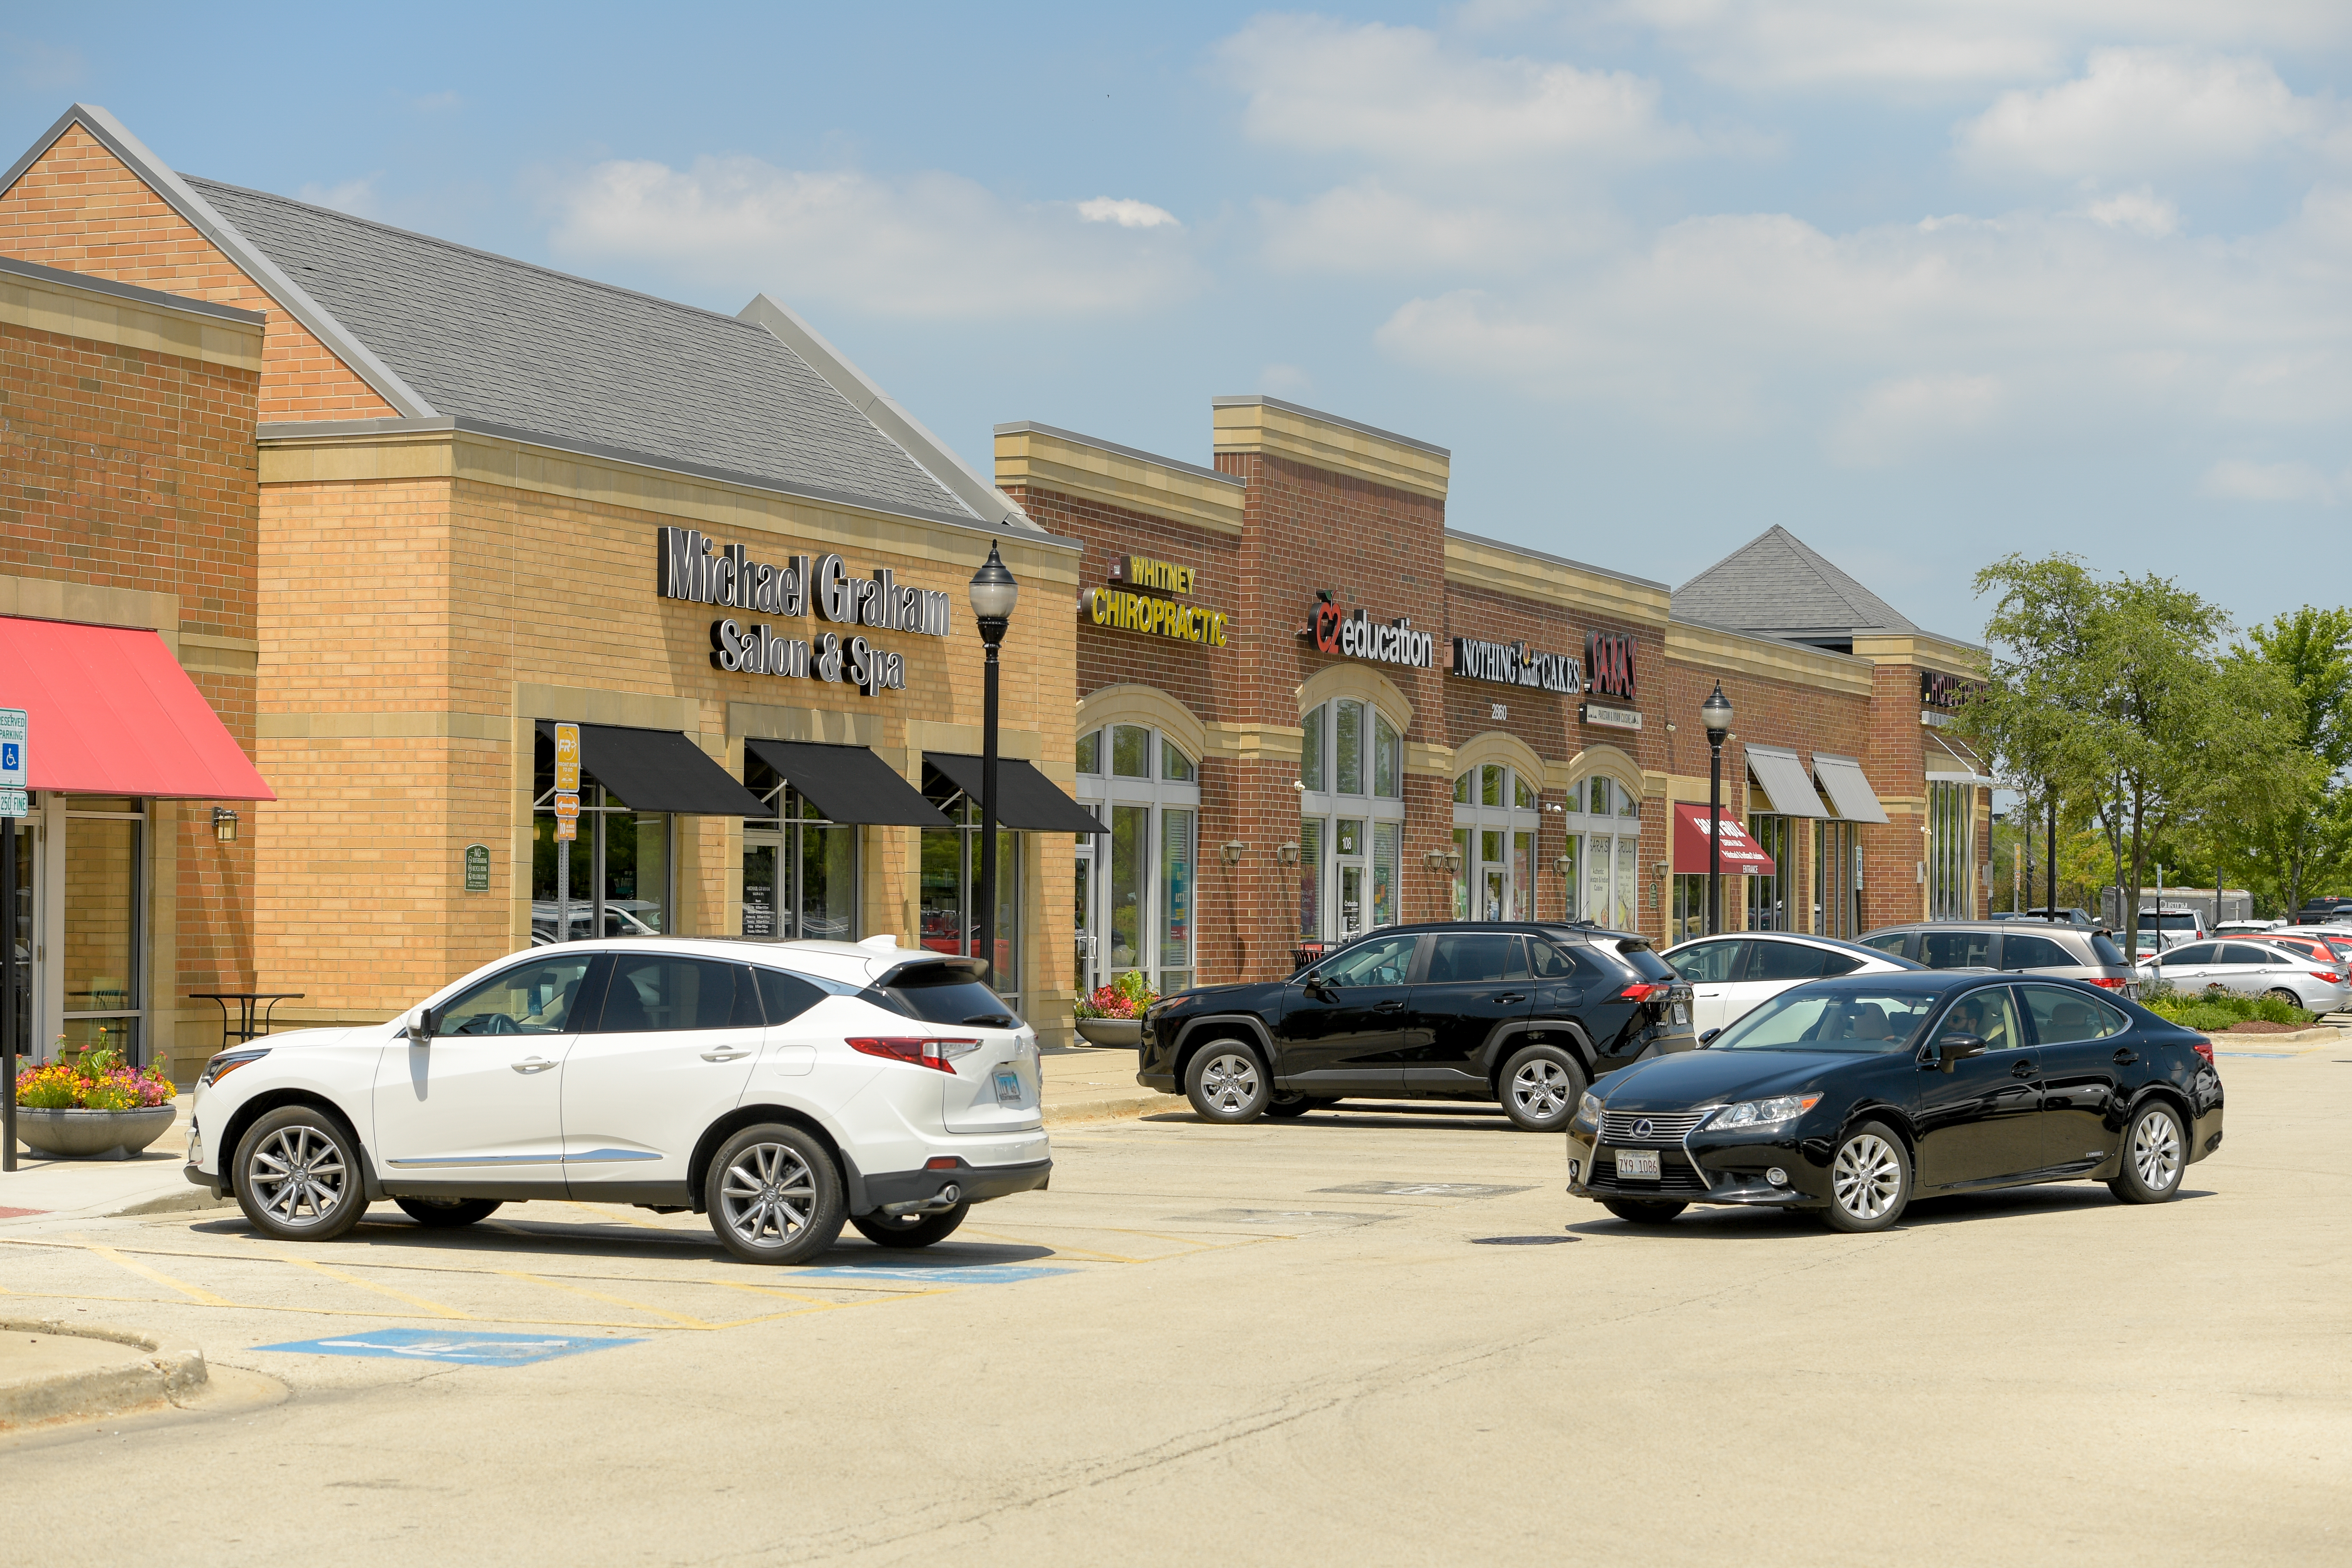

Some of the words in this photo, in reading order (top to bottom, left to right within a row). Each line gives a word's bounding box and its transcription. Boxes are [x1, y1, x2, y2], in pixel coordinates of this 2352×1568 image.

[666, 526, 809, 618] Michael
[816, 553, 950, 637] Graham
[1130, 555, 1196, 595] WHITNEY
[1091, 587, 1228, 648] CHIROPRACTIC
[1342, 609, 1433, 668] education
[717, 619, 810, 679] Salon
[818, 632, 843, 683] &
[850, 636, 906, 697] Spa
[1462, 638, 1516, 683] NOTHING
[1517, 642, 1542, 688] bundt
[1542, 653, 1580, 694] CAKES
[1591, 629, 1638, 701] SARA'S
[1492, 703, 1507, 721] 2860
[0, 729, 23, 740] PARKING
[14, 797, 26, 811] FINE
[560, 822, 566, 835] 10
[1342, 837, 1352, 850] 108
[1590, 838, 1608, 853] SARA'S
[1617, 841, 1632, 857] GRILL
[474, 848, 481, 858] NO
[1742, 865, 1758, 874] ENTRANCE
[2159, 899, 2188, 909] CUSTOM
[1619, 1158, 1633, 1173] ZY9
[1639, 1159, 1658, 1173] 1086
